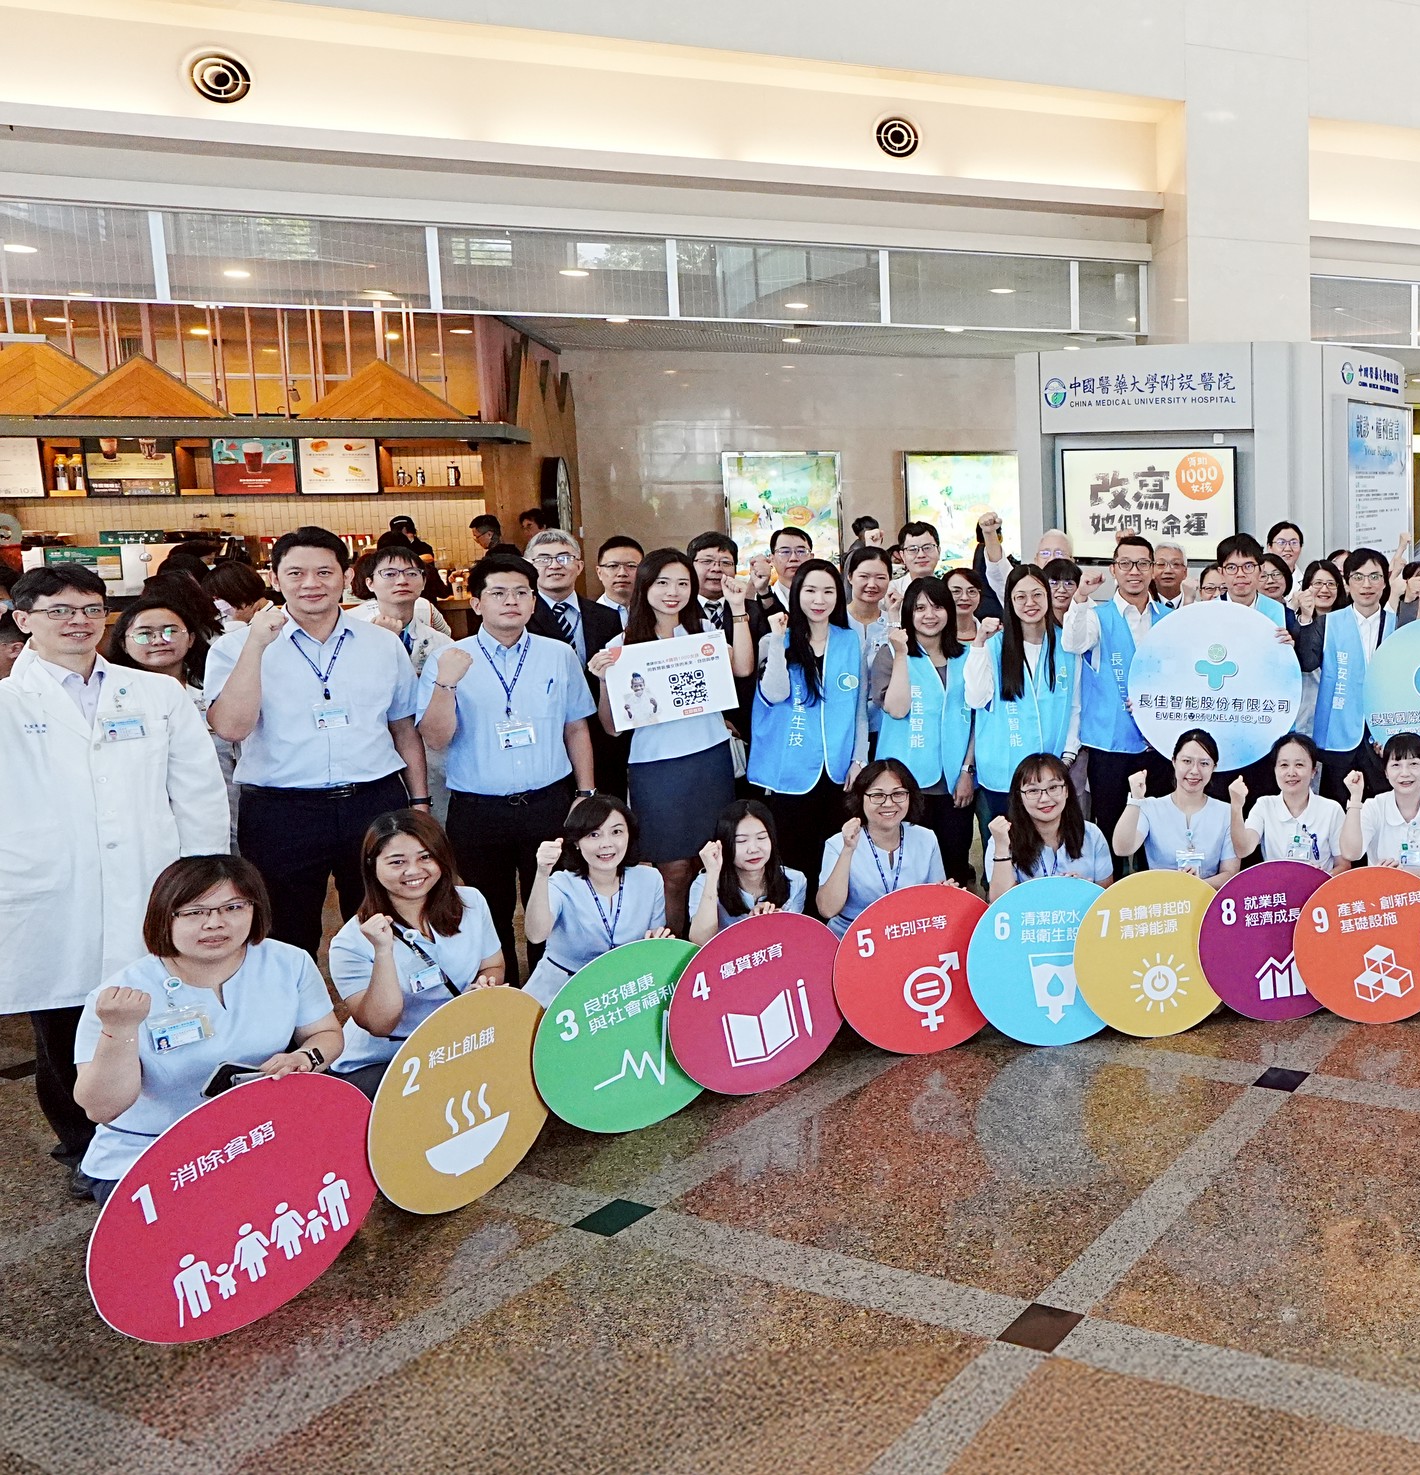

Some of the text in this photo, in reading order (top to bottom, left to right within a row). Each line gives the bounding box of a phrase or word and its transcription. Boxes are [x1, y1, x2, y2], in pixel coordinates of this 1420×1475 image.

[1069, 372, 1236, 397] 中國醫藥大學附設醫院
[1069, 396, 1236, 408] CHINA MEDICAL UNIVERSITY HOSPITAL
[1181, 465, 1218, 483] 1000
[1089, 465, 1170, 512] 改寫
[1190, 483, 1213, 494] 女孩
[1089, 512, 1209, 538] 她們的命運
[1332, 651, 1349, 710] 聖安生醫
[910, 685, 925, 749] 長佳智能
[1139, 694, 1291, 713] 長佳智能股份有限公司
[1119, 900, 1191, 923] 負擔得起的
[1221, 898, 1237, 926] 8
[1244, 892, 1287, 911] 就業與
[884, 914, 947, 940] 性別平等
[994, 911, 1011, 941] 6
[1020, 909, 1081, 927] 清潔飲水
[1096, 909, 1110, 938] 7
[1120, 919, 1178, 940] 清淨能源
[1245, 907, 1301, 928] 經濟成長
[1312, 906, 1329, 933] 9
[1340, 911, 1398, 934] 基礎設施
[856, 929, 875, 958] 5
[719, 942, 783, 980] 優質教育
[583, 972, 656, 1018] 良好健康
[692, 971, 711, 1001] 4
[588, 982, 676, 1036] 與社會福利
[555, 1009, 580, 1042] 3
[428, 1026, 495, 1069] 終止飢餓
[402, 1056, 421, 1097] 2
[170, 1120, 276, 1192] 消除貧窮
[131, 1184, 158, 1225] 1
